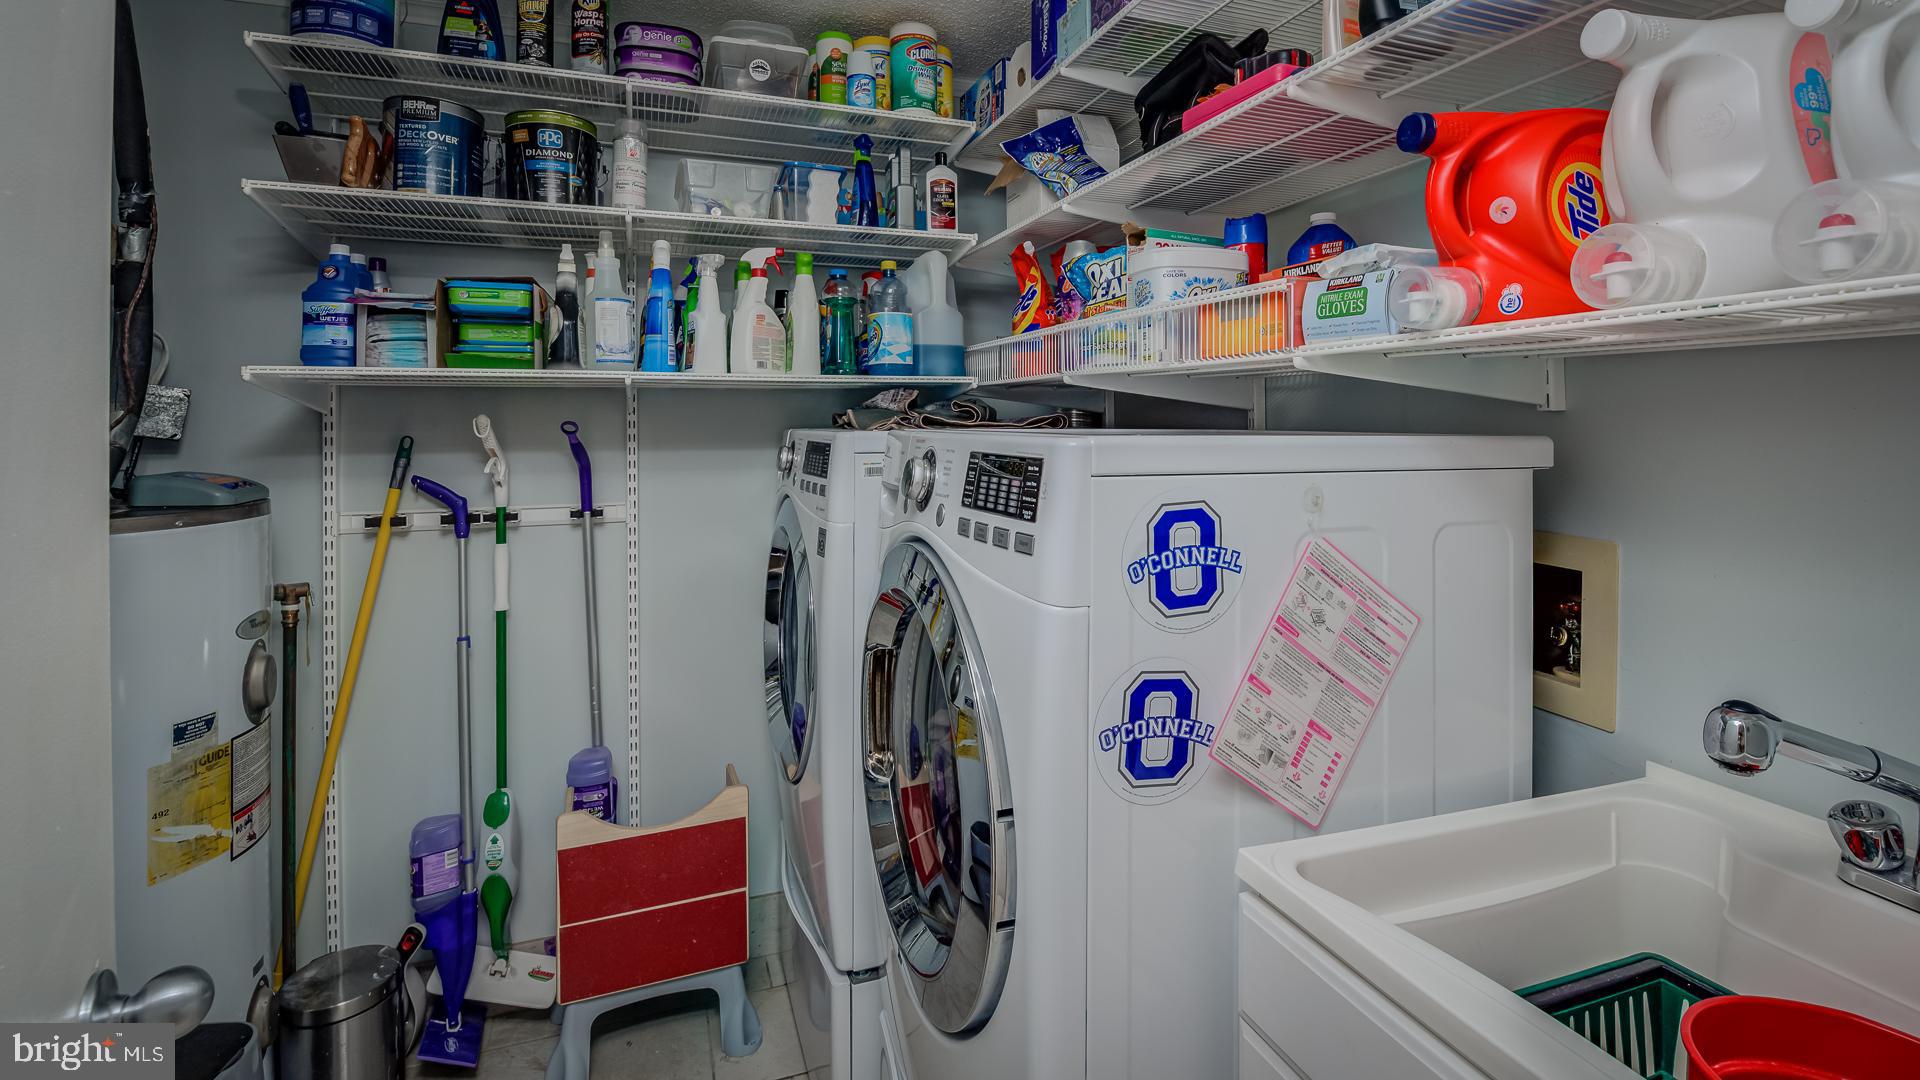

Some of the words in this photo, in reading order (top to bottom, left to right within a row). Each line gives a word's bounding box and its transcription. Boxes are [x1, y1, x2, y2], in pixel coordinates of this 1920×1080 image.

[574, 9, 598, 19] Wasp
[574, 19, 604, 27] Hornet
[643, 30, 672, 42] genie
[402, 99, 426, 110] BEHR
[402, 108, 437, 117] PREMIUM
[539, 131, 561, 146] PPG
[525, 149, 573, 159] DIAMOND
[1567, 170, 1600, 240] Tide
[1321, 241, 1342, 250] BETTER
[1321, 247, 1342, 255] VALUE!
[1087, 258, 1122, 288] OXI
[1329, 275, 1363, 286] KIRKLAND
[1088, 276, 1126, 305] LEA
[1321, 294, 1342, 303] NITRILE
[1344, 290, 1363, 300] EXAM
[308, 304, 336, 315] Swiffer
[1318, 299, 1364, 316] GLOVES
[1127, 545, 1242, 584] O'CONNELL
[1099, 717, 1215, 752] O'CONNELL
[199, 745, 230, 764] GUIDE
[151, 808, 170, 821] 492
